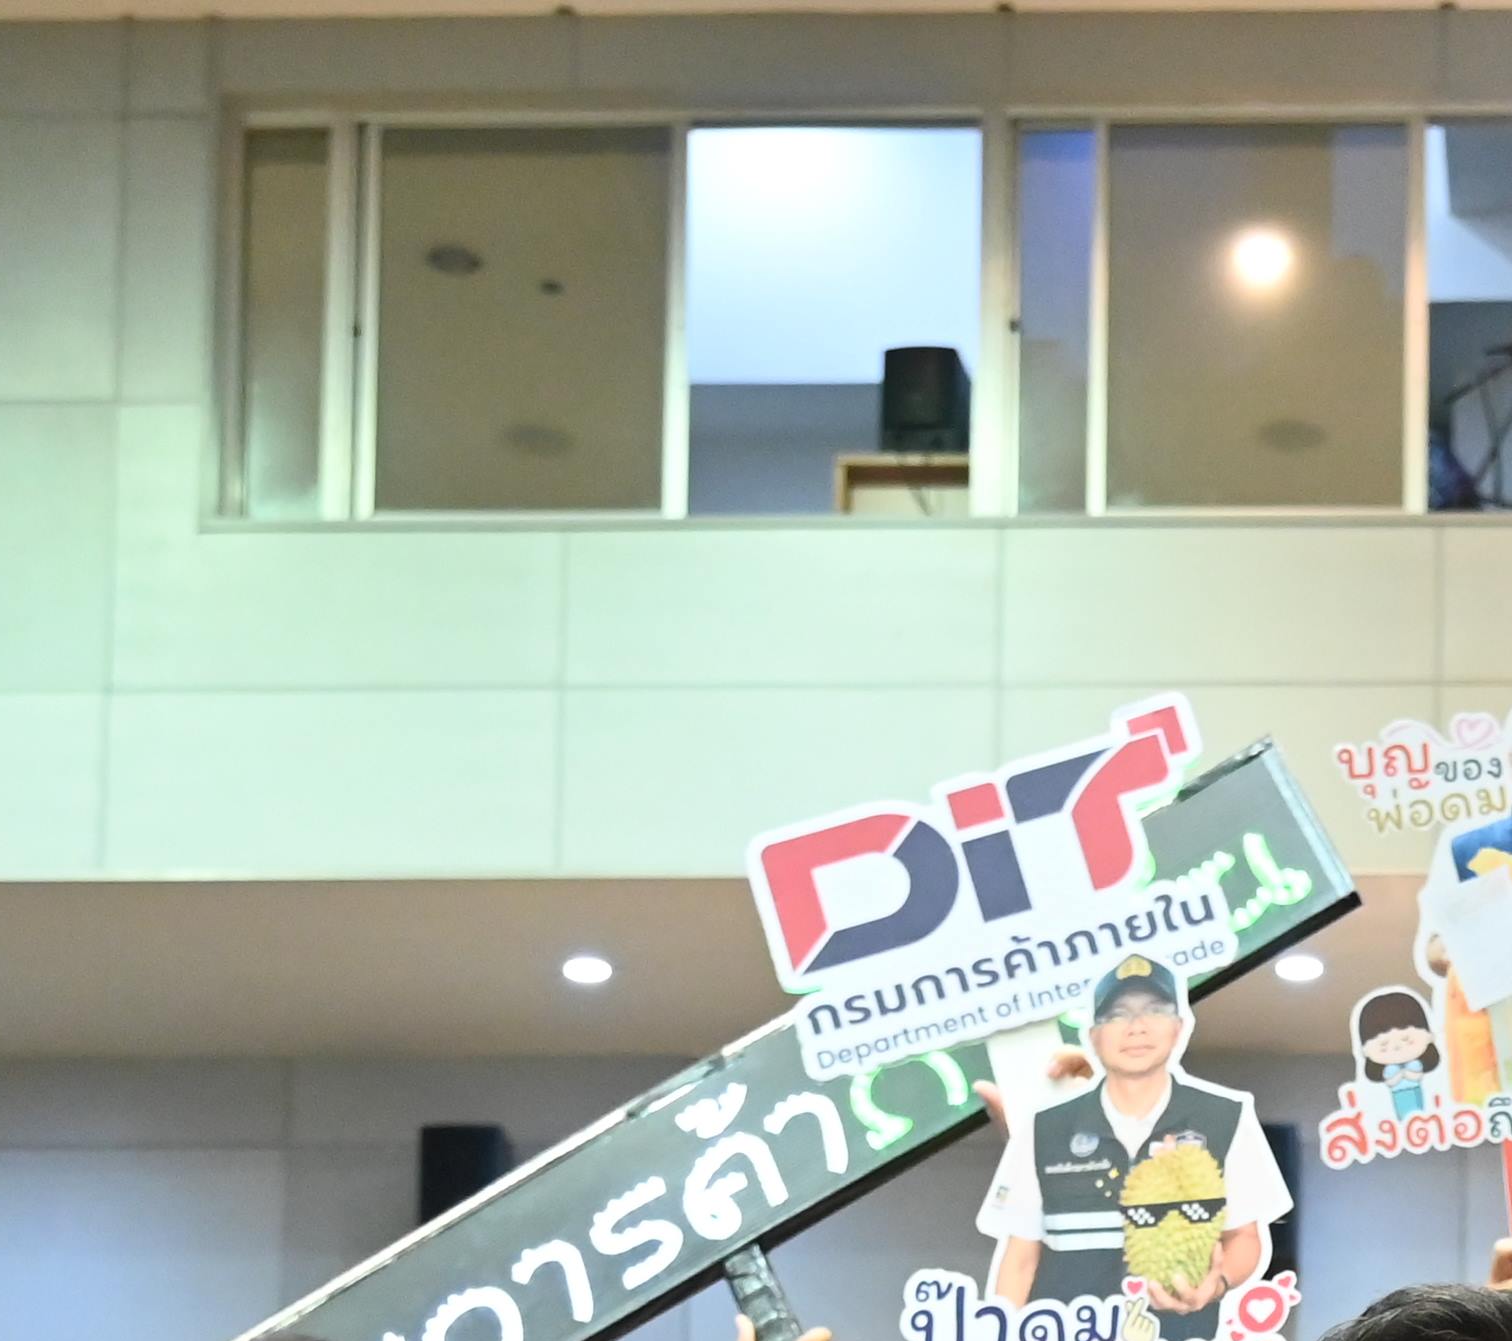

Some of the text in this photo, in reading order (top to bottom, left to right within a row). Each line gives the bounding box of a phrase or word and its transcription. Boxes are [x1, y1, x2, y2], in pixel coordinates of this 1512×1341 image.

[1367, 783, 1508, 834] พ่อดม
[807, 893, 1216, 1035] กรมการค้าภายใน
[816, 1006, 988, 1071] Department
[995, 990, 1022, 1018] of
[1028, 977, 1090, 1009] Inter
